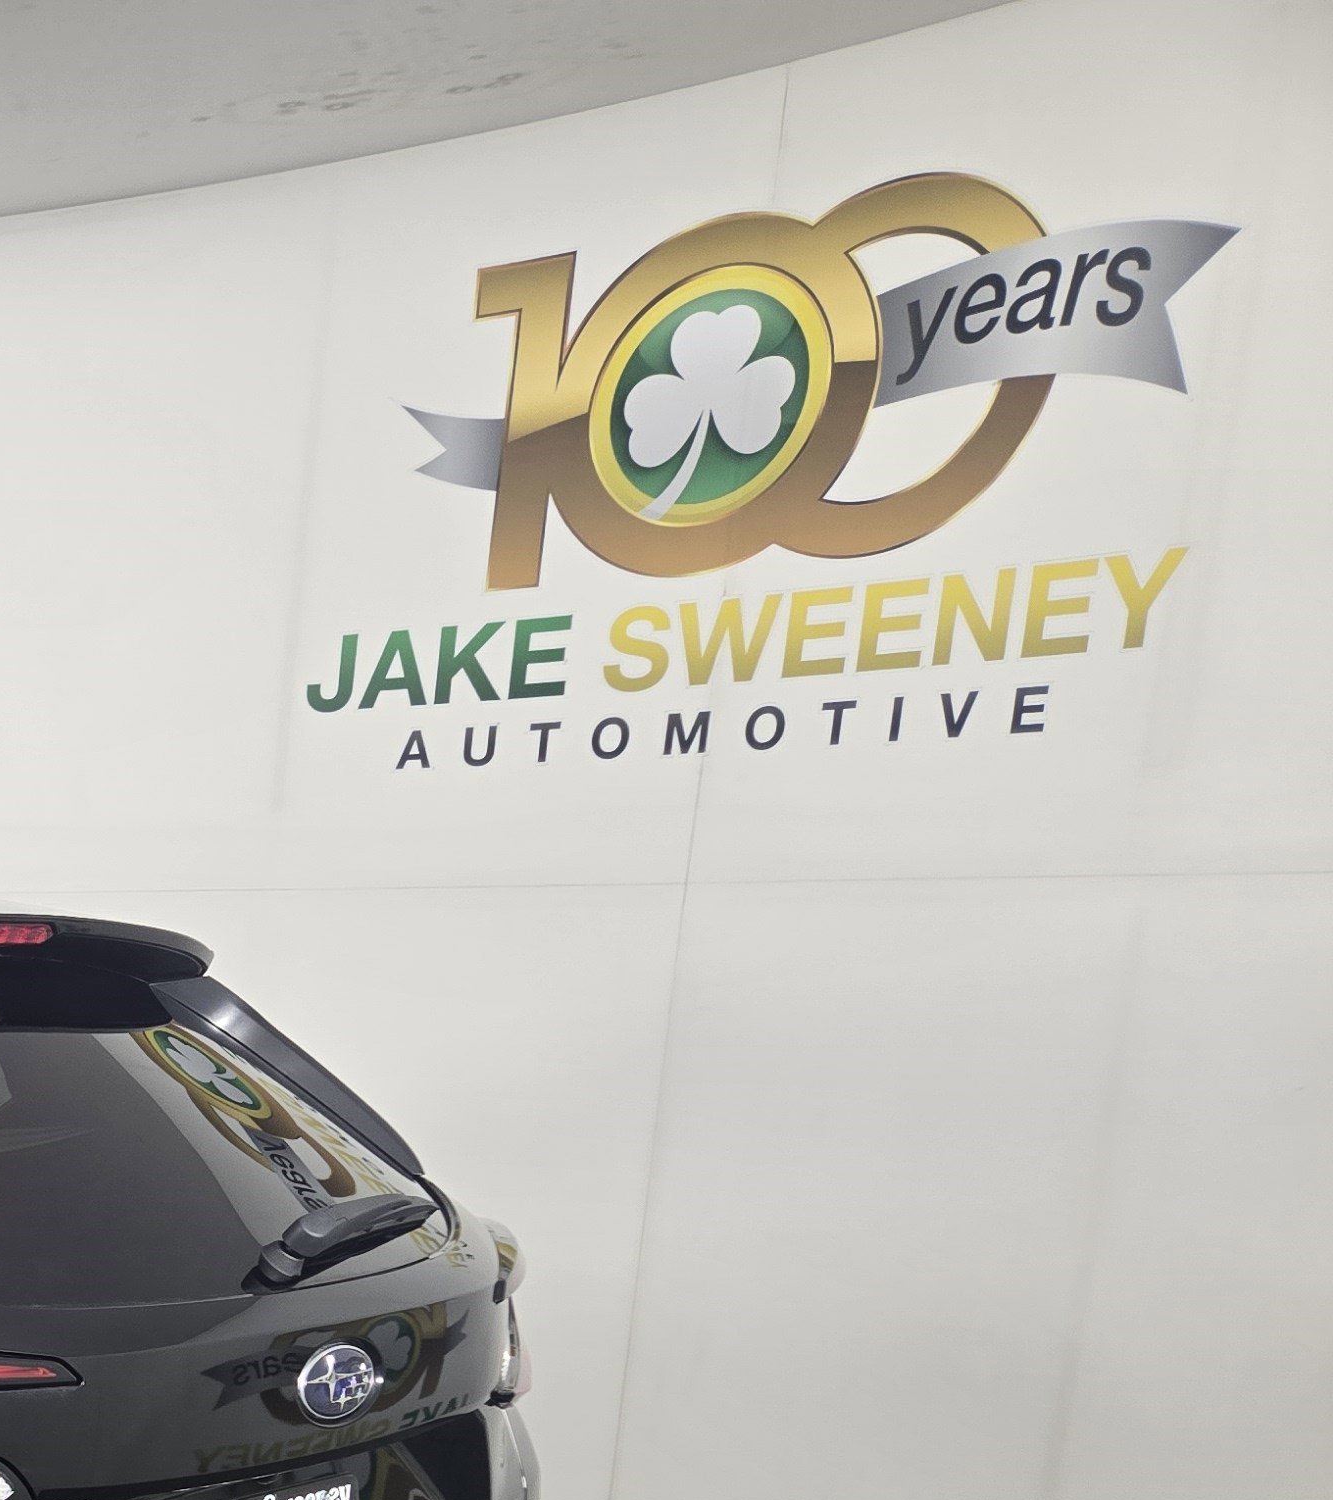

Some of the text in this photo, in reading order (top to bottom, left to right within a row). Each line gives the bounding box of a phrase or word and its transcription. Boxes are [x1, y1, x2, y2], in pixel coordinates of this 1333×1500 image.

[894, 245, 1151, 386] years
[306, 546, 1188, 714] JAKE SWEENEY
[394, 685, 1051, 771] AUTOMOTIVE
